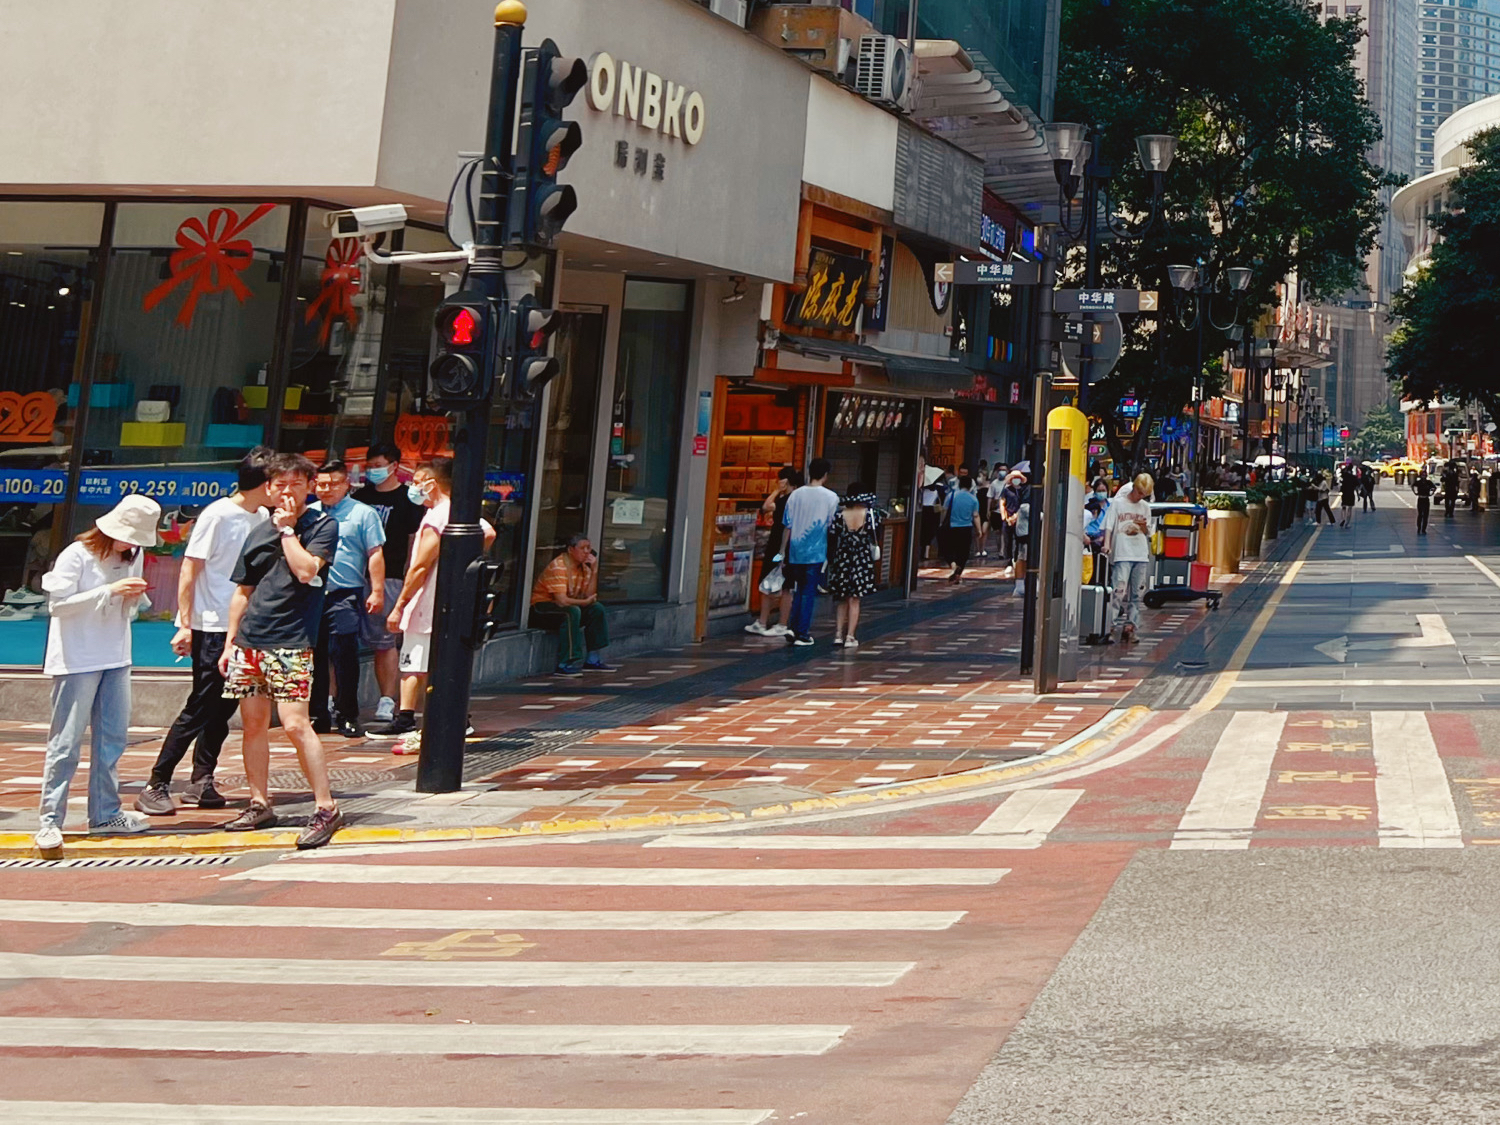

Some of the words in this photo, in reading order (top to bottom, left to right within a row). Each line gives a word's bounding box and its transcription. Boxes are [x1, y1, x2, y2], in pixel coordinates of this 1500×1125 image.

[587, 51, 705, 146] ONBKO
[976, 264, 1014, 275] 中华路
[1078, 292, 1115, 304] 中华路
